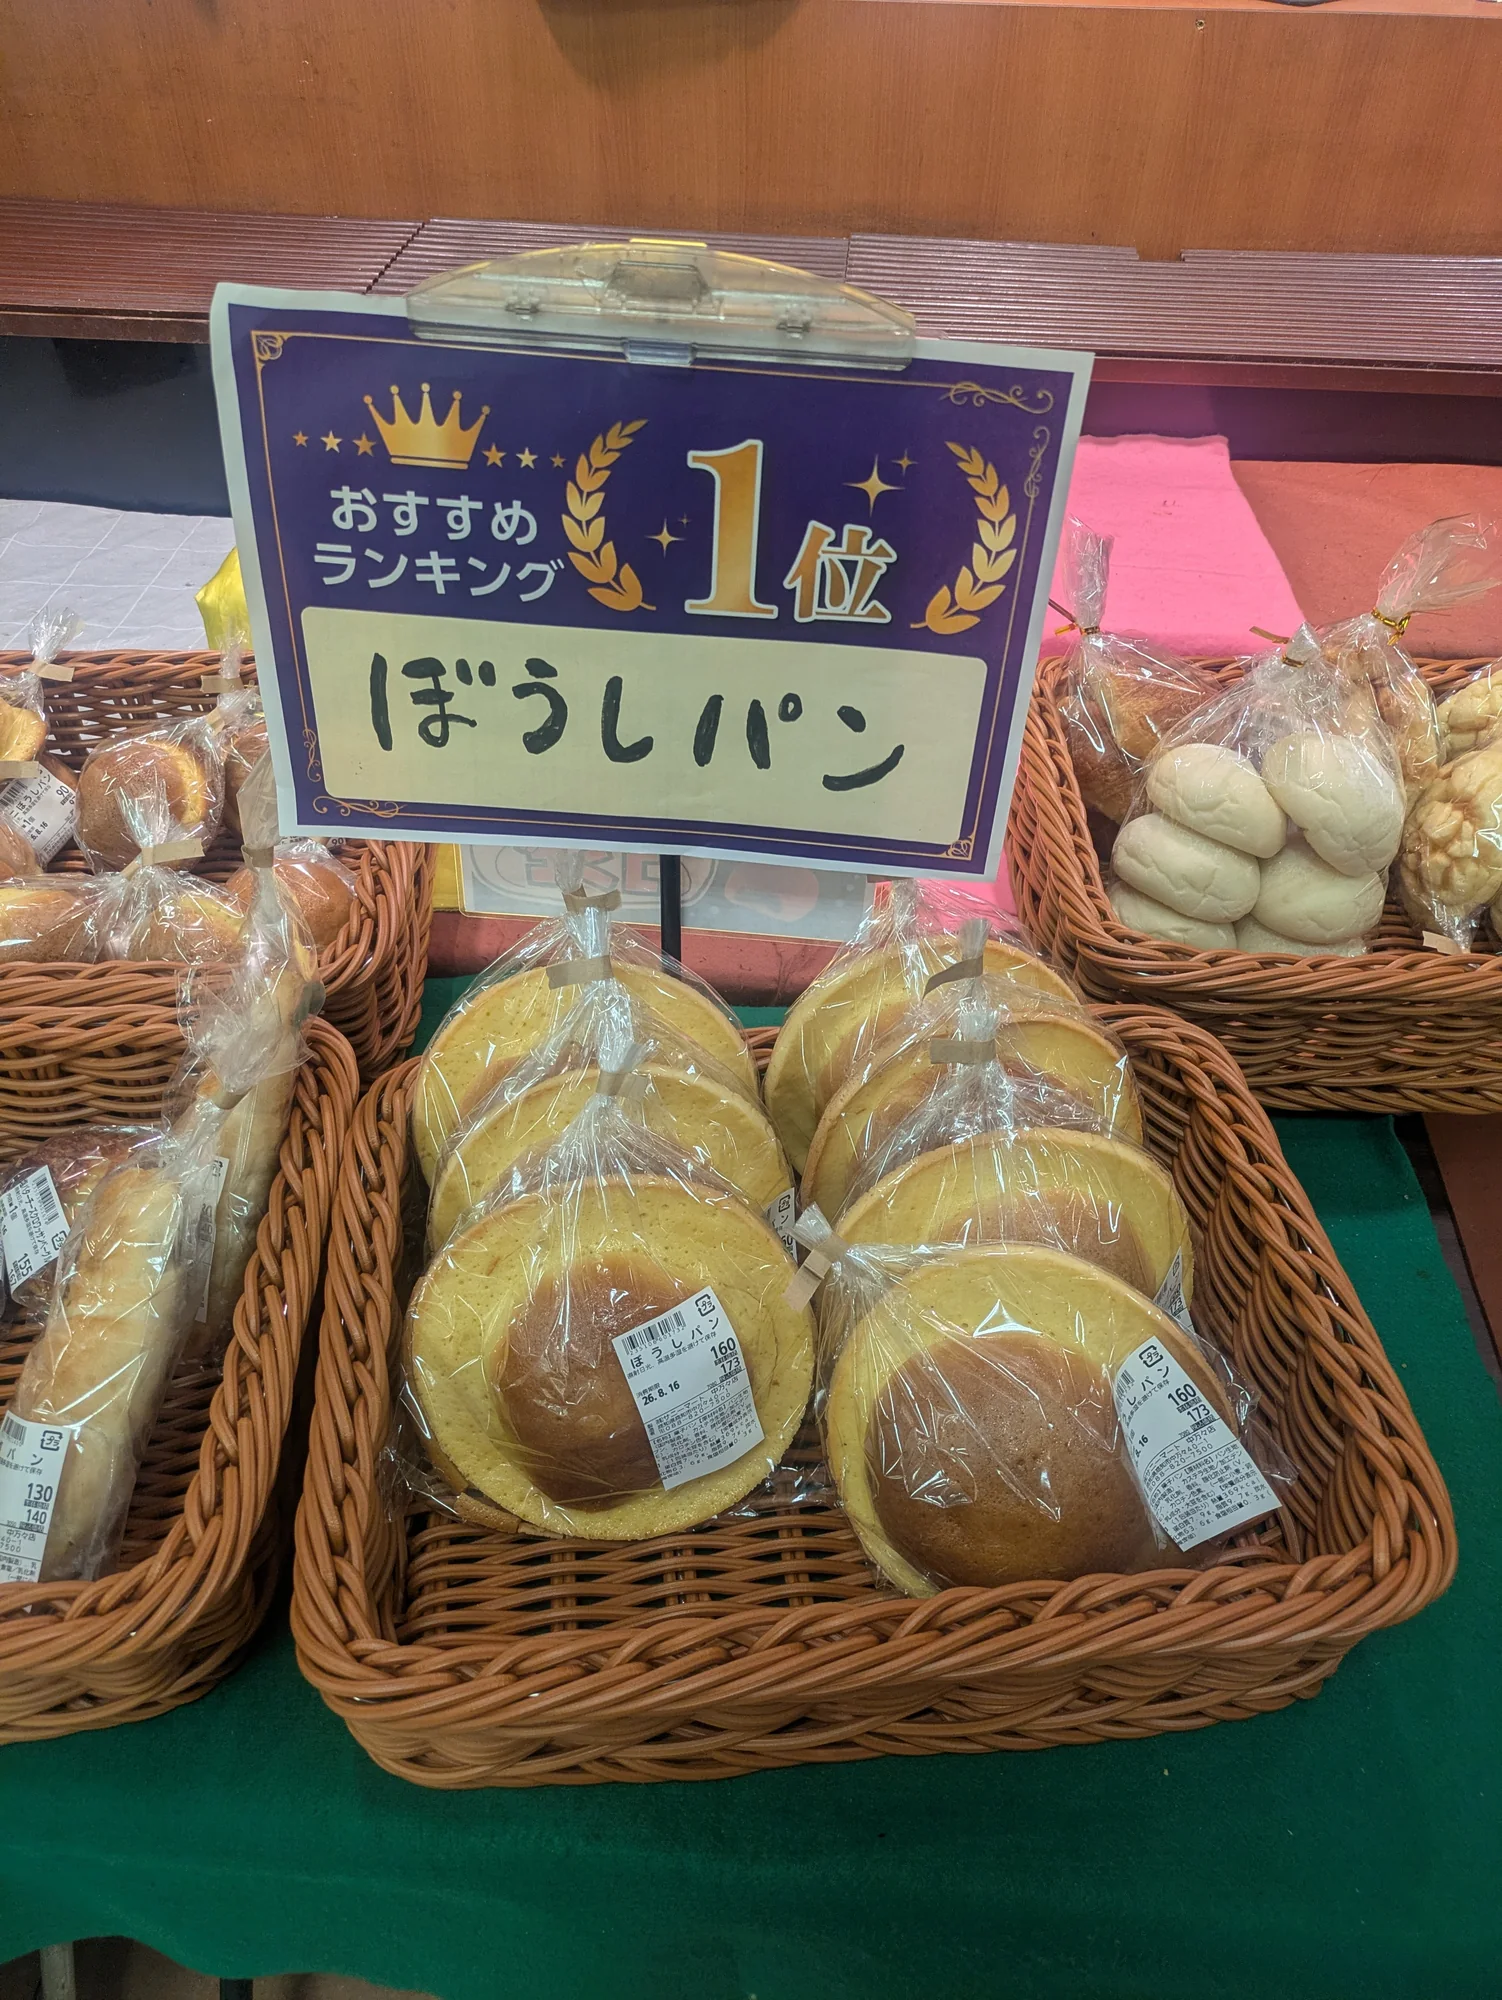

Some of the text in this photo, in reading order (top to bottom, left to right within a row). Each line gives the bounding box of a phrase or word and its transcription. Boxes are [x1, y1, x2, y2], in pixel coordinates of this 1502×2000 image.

[330, 485, 538, 545] おすすめ
[684, 438, 898, 624] 1位
[314, 543, 565, 602] ランキング
[370, 652, 905, 792] ぼうしパン
[55, 784, 69, 797] 90
[17, 1252, 32, 1277] 155
[628, 1315, 722, 1369] ぼうしパン
[708, 1336, 737, 1359] 160
[719, 1356, 741, 1373] 173
[1166, 1381, 1197, 1406] 160
[1185, 1402, 1210, 1423] 173
[1186, 1424, 1216, 1445] 中万々店
[27, 1481, 53, 1502] 130
[27, 1508, 47, 1524] 140
